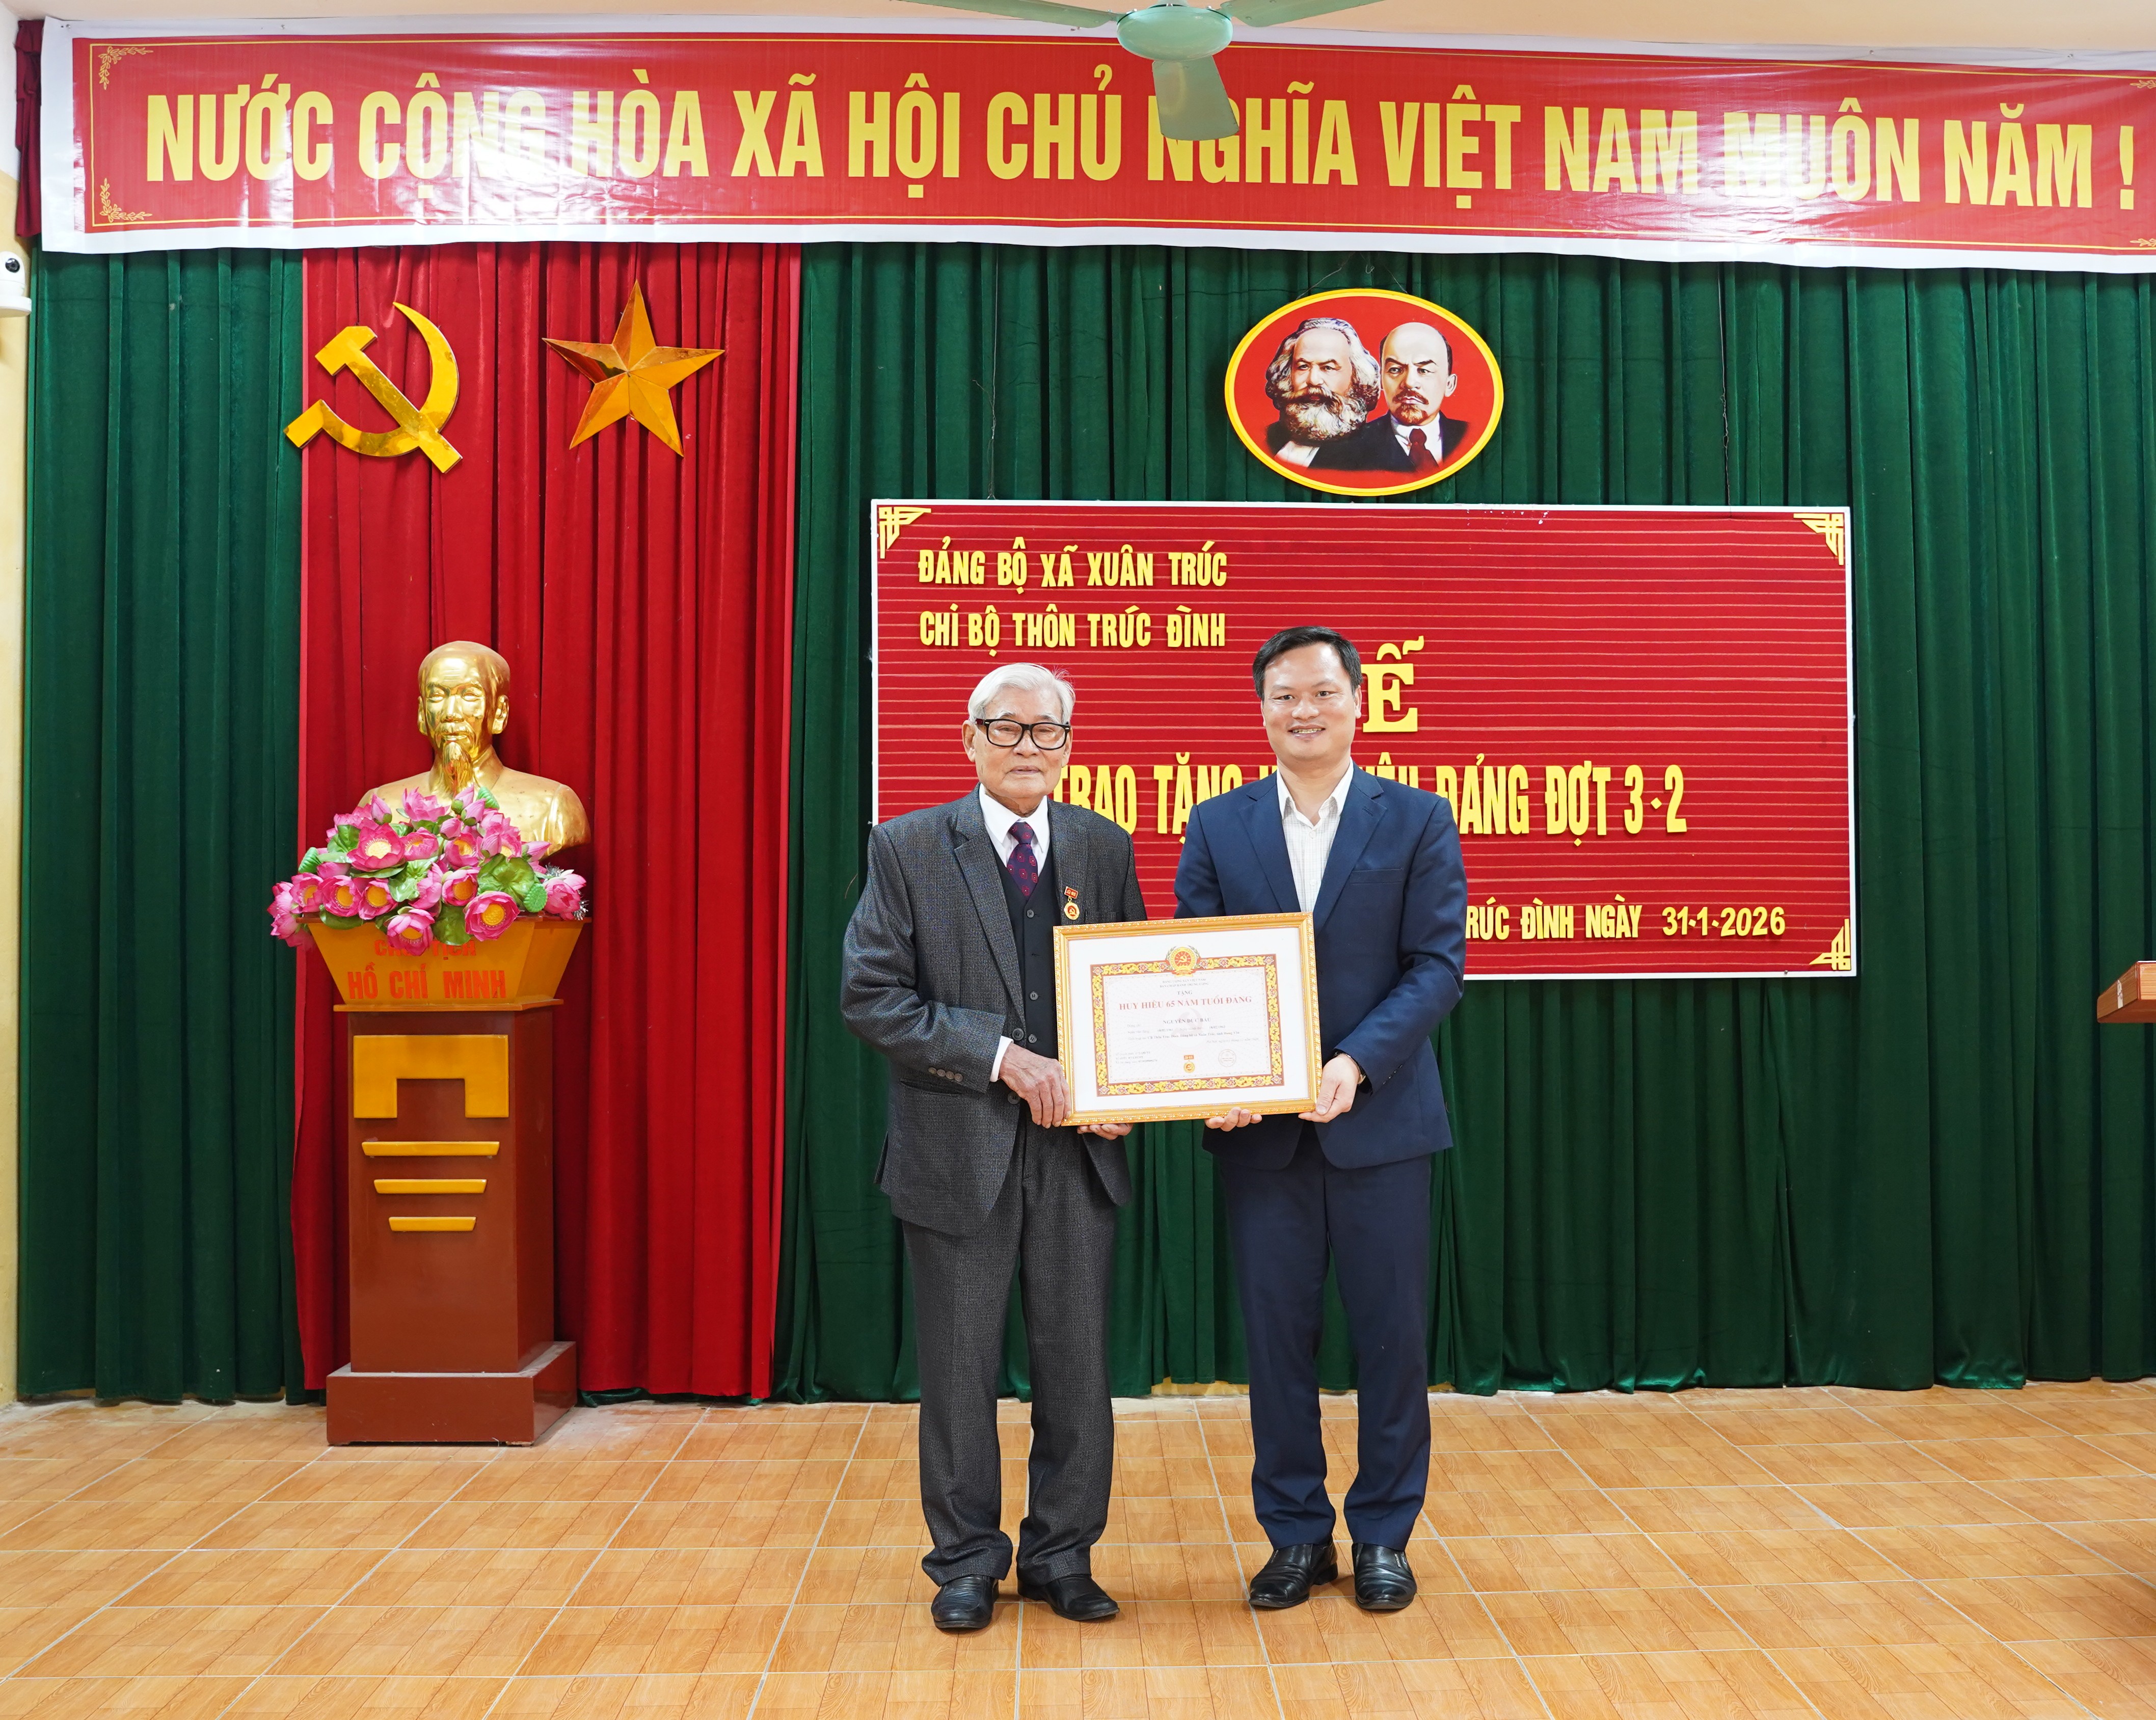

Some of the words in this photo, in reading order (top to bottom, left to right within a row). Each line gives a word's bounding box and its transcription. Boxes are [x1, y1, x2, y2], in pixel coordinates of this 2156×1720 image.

[147, 74, 334, 182] NƯỚC
[359, 72, 546, 199] CỘNG
[571, 69, 710, 178] HÒA
[731, 73, 824, 177] XÃ
[848, 73, 960, 198] HỘI
[987, 64, 1122, 181] CHỦ
[1379, 85, 1521, 209] VIỆT
[1544, 106, 1698, 195] NAM
[1724, 97, 1920, 202] MUÔN
[1944, 103, 2092, 208] NĂM
[918, 536, 985, 585] ĐẢNG
[998, 536, 1027, 595] BỘ
[1040, 544, 1079, 587] XÃ
[1087, 544, 1153, 586] XUÂN
[1168, 541, 1227, 586] TRÚC
[968, 605, 1000, 657] BỘ
[1012, 603, 1075, 648] THÔN
[1087, 605, 1151, 648] TRÚC
[1166, 605, 1226, 648] ĐÌNH
[1361, 635, 1424, 733] Ễ
[1545, 760, 1611, 847] ĐỢT
[1466, 896, 1510, 940] RÚC
[1520, 897, 1574, 939] ĐÌNH
[1585, 894, 1642, 938] NGÀY
[389, 963, 428, 999] CHÍ
[443, 970, 506, 999] MINH
